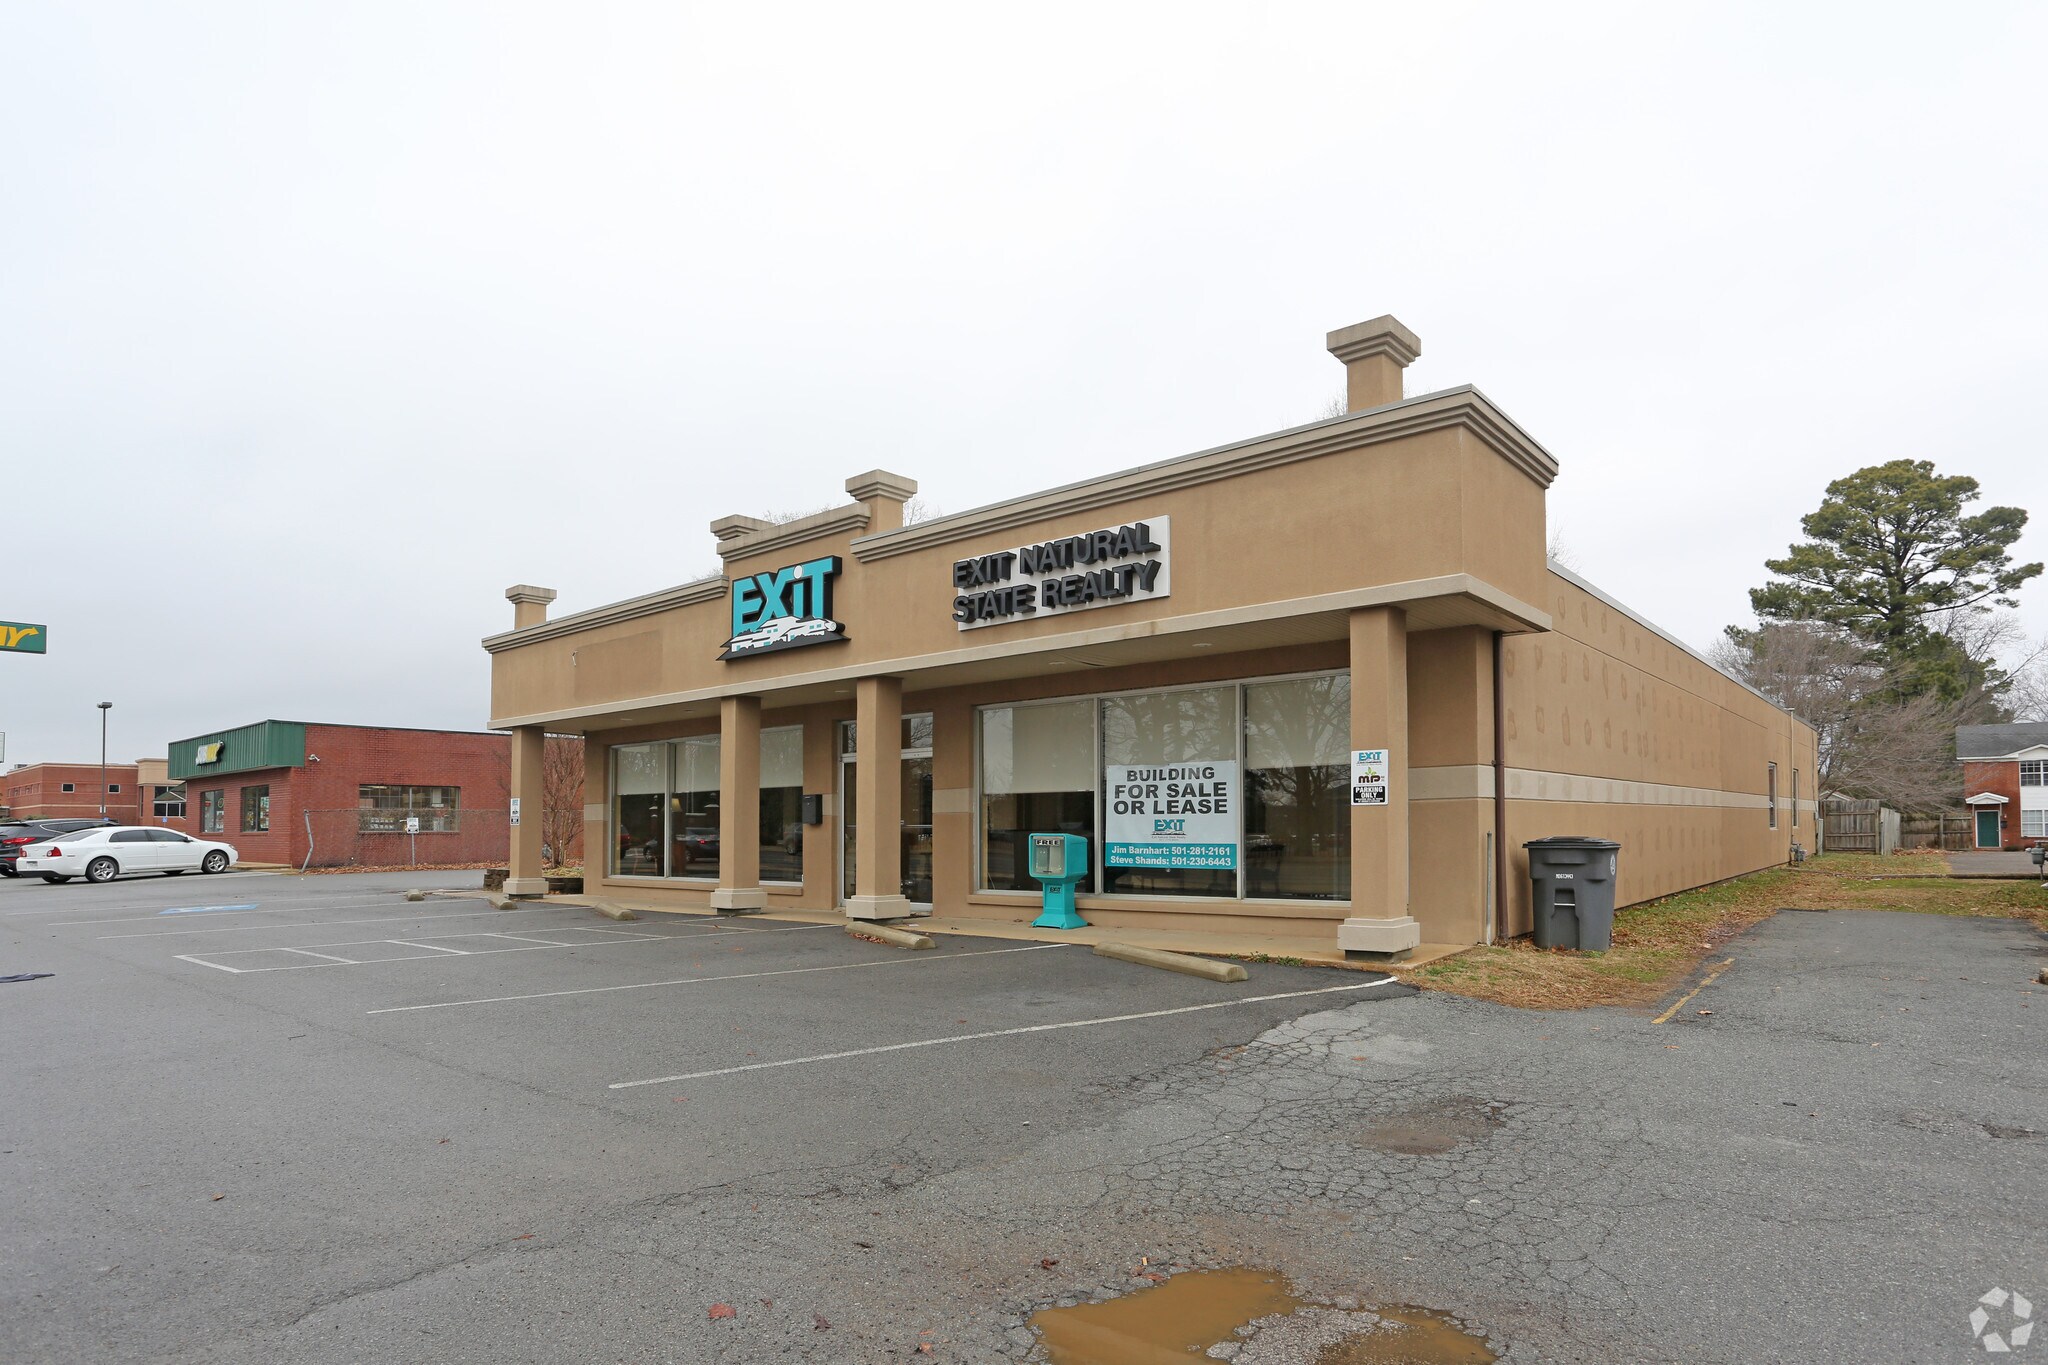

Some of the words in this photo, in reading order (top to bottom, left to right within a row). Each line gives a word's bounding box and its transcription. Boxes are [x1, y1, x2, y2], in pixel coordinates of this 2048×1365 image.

[953, 551, 1016, 588] EXIT
[1020, 522, 1161, 575] NATURAL
[952, 584, 1036, 623] STATE
[1042, 559, 1162, 608] REALTY
[1126, 767, 1215, 782] BUILDING
[1114, 784, 1159, 799] FOR
[1166, 782, 1227, 798] SALE
[1113, 801, 1145, 815] OR
[1153, 799, 1228, 815] LEASE
[1111, 846, 1127, 854] Jim
[1129, 846, 1169, 855] Barnhart:
[1171, 847, 1230, 855] 501-281-2161
[1111, 856, 1133, 864] Steve
[1135, 857, 1169, 865] Shands:
[1171, 857, 1232, 866] 501-230-6443
